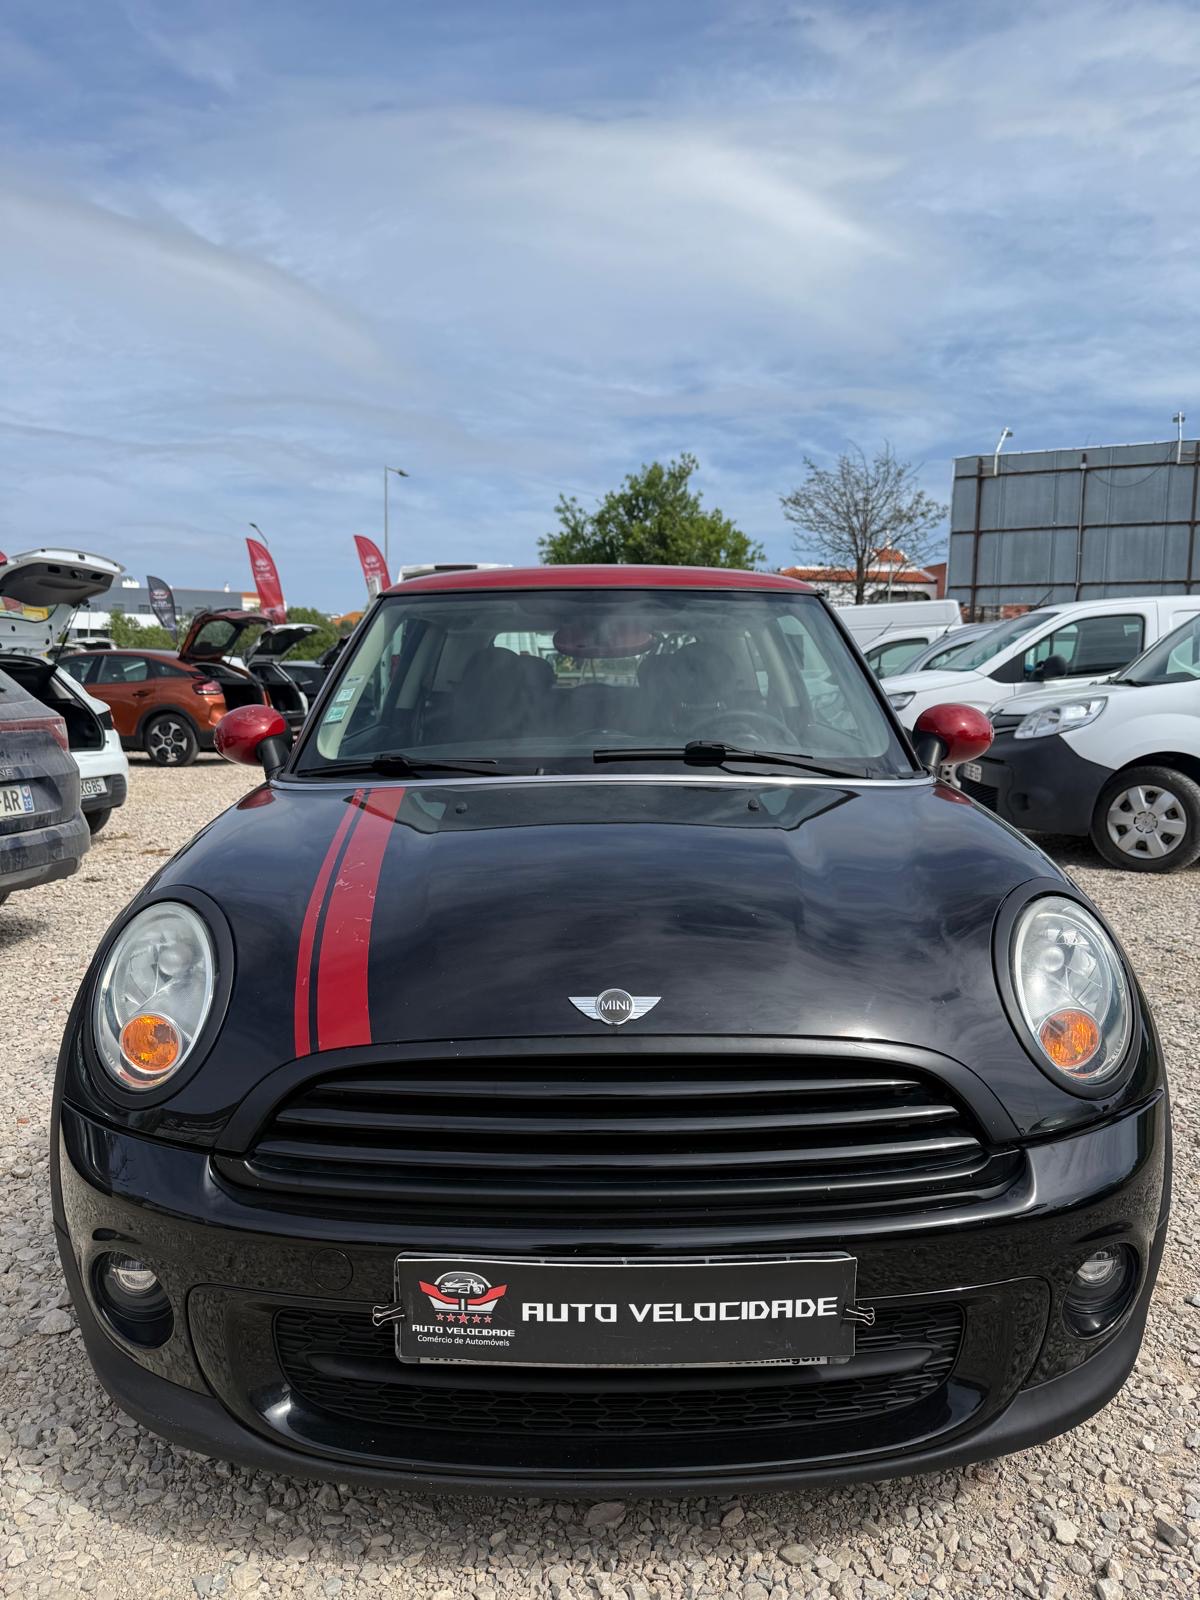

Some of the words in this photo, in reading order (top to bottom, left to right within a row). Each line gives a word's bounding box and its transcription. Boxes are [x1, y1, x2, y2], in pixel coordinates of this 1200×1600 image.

[601, 1000, 630, 1011] MINI
[522, 1302, 617, 1323] AUTO
[628, 1296, 838, 1323] VELOCIDADE
[412, 1324, 443, 1333] AUTO
[446, 1327, 515, 1337] VELOCIDADE
[417, 1335, 453, 1344] Comércio
[465, 1338, 510, 1347] Automóveis
